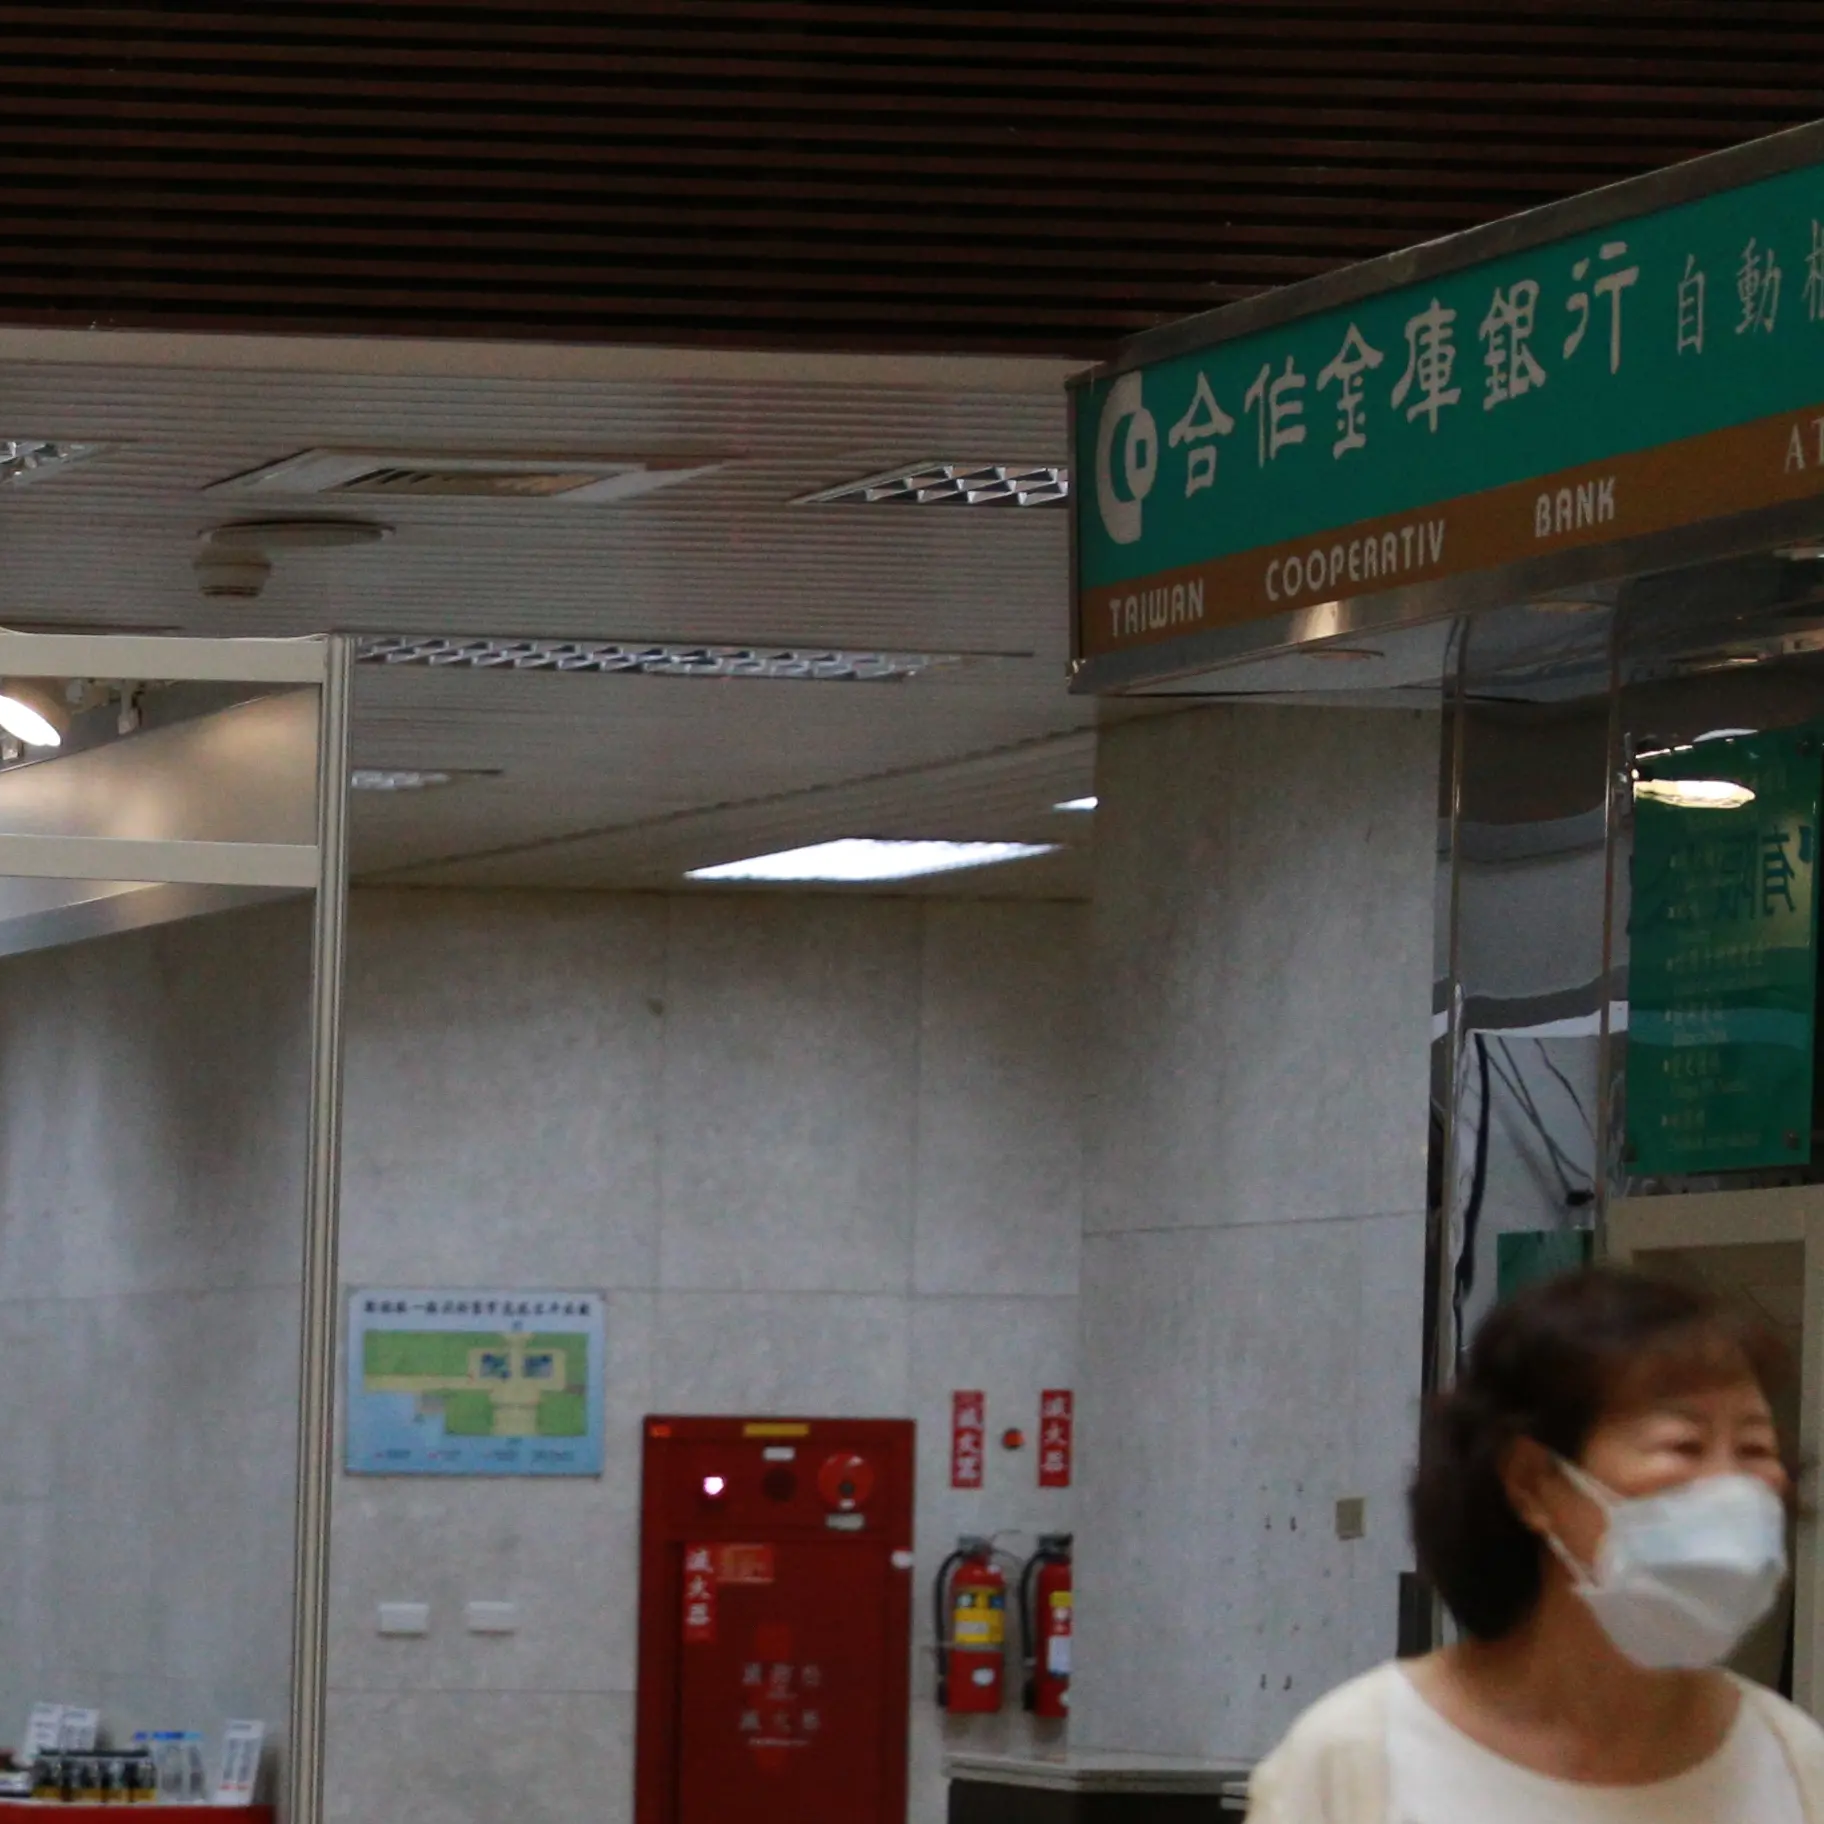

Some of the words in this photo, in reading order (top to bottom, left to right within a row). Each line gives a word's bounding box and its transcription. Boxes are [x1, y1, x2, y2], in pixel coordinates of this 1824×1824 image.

[1677, 219, 1824, 356] 自動
[1168, 241, 1640, 499] 合作金庫銀行
[1110, 577, 1205, 640] TAIWAN
[1265, 519, 1446, 601] COOPERATIV
[1535, 476, 1616, 539] BANK
